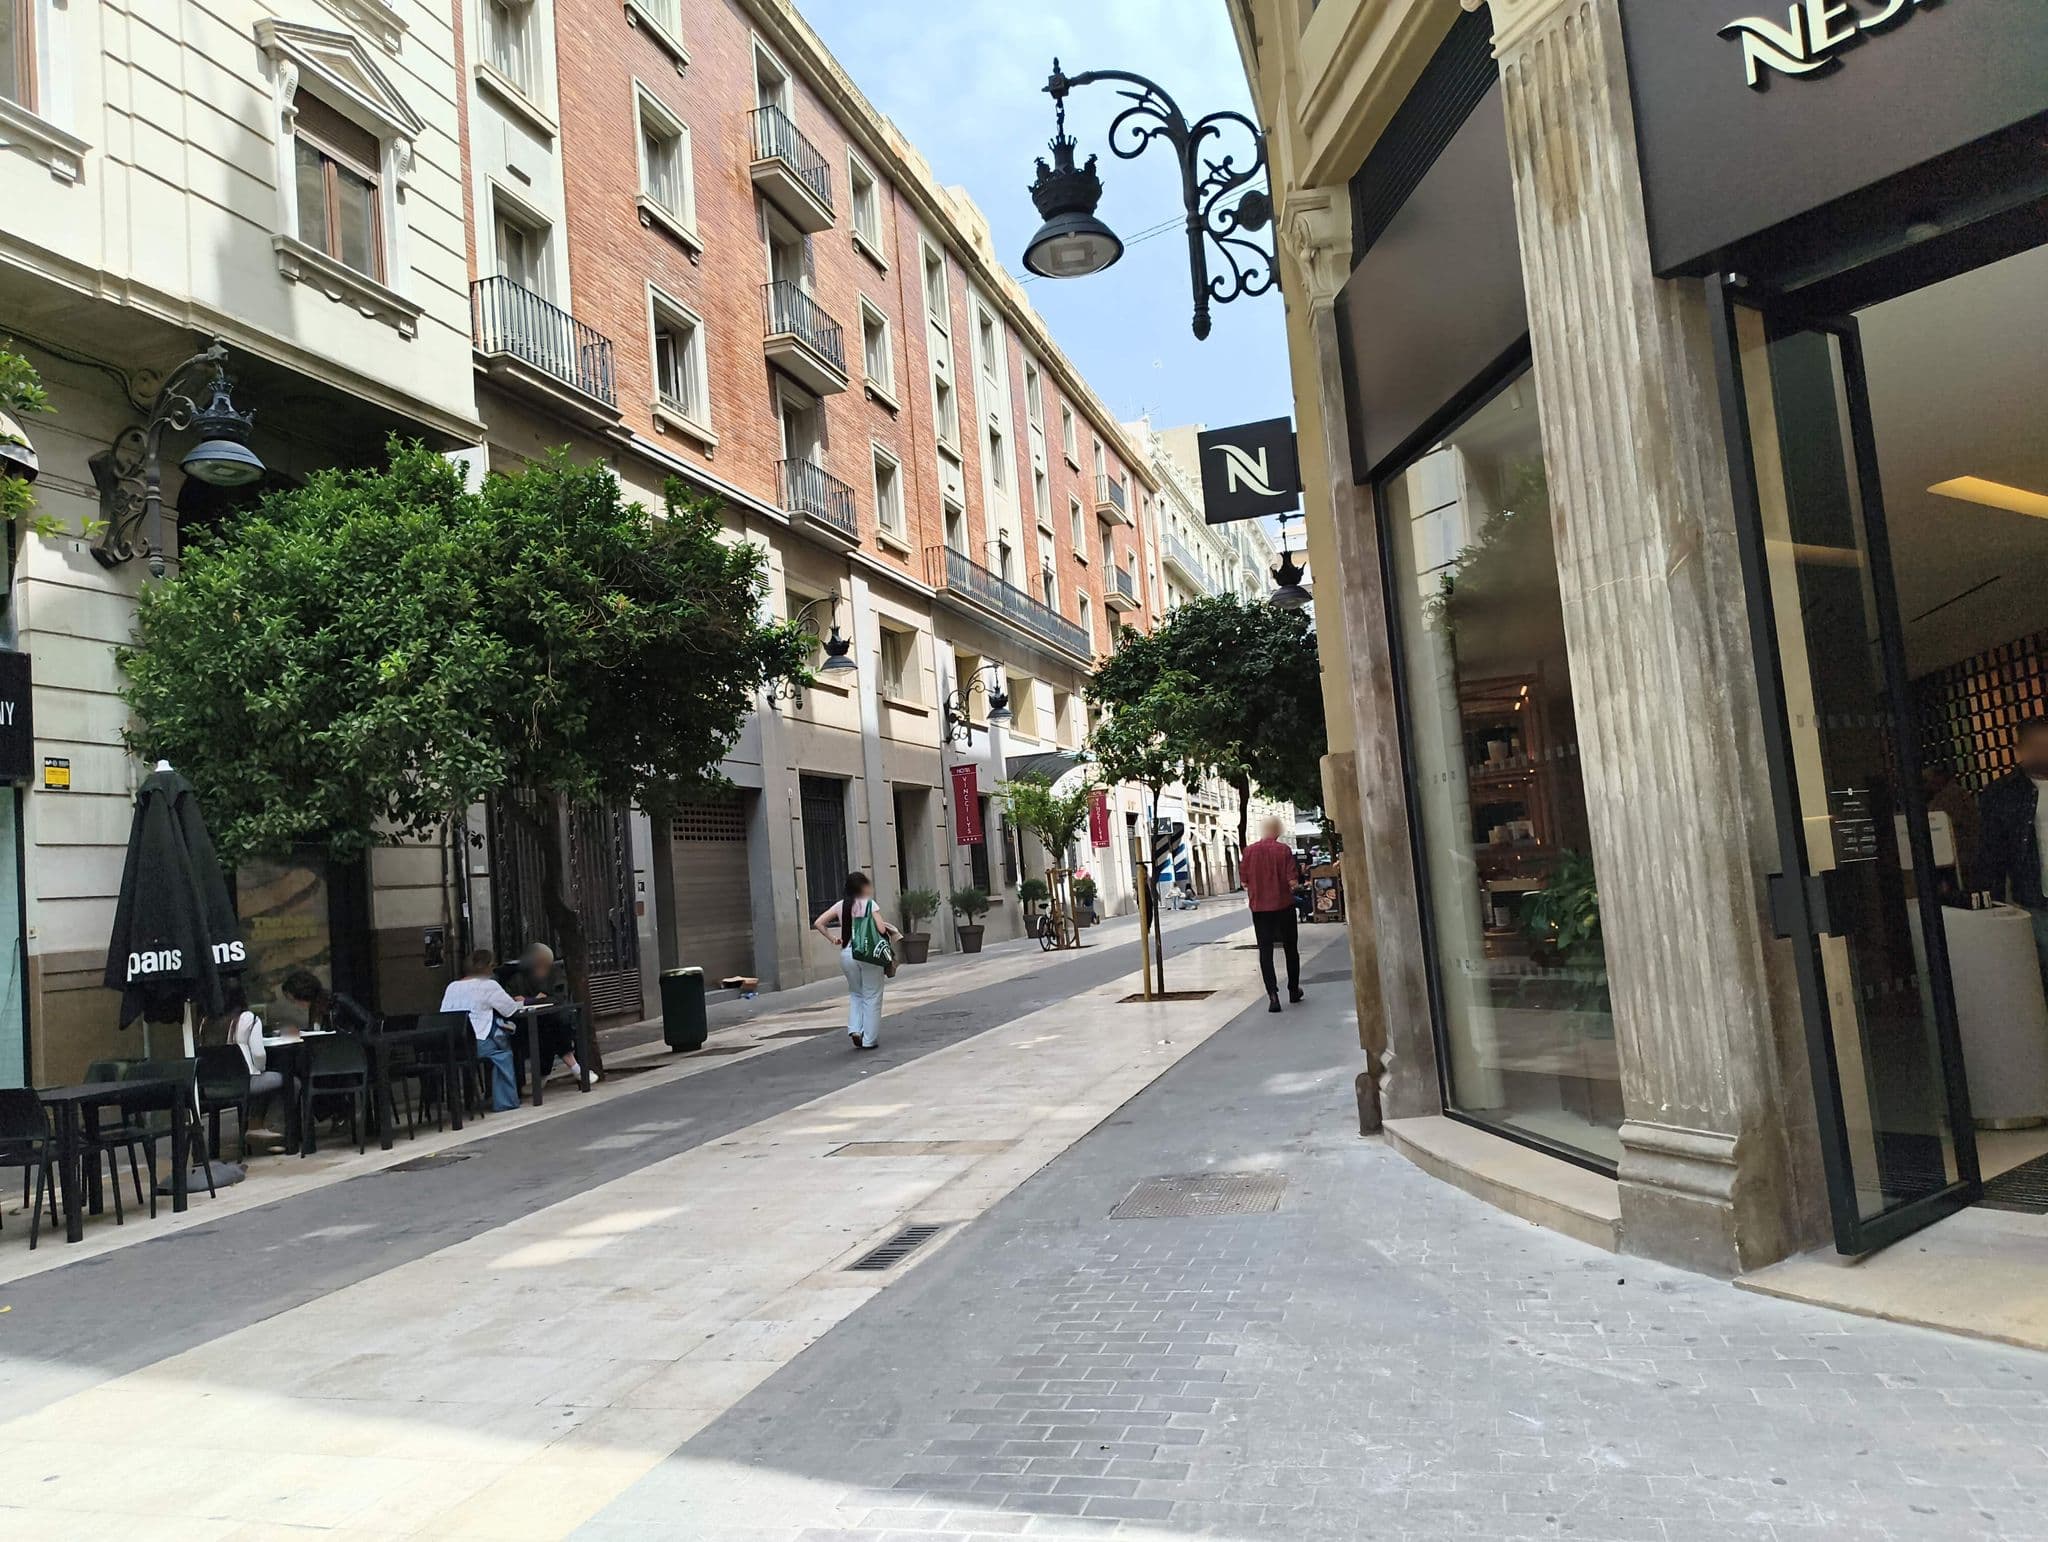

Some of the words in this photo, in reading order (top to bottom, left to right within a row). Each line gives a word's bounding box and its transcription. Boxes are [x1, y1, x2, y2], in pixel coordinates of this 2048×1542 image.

[1209, 444, 1287, 496] N
[962, 775, 970, 813] VINCCI
[126, 949, 182, 982] pans
